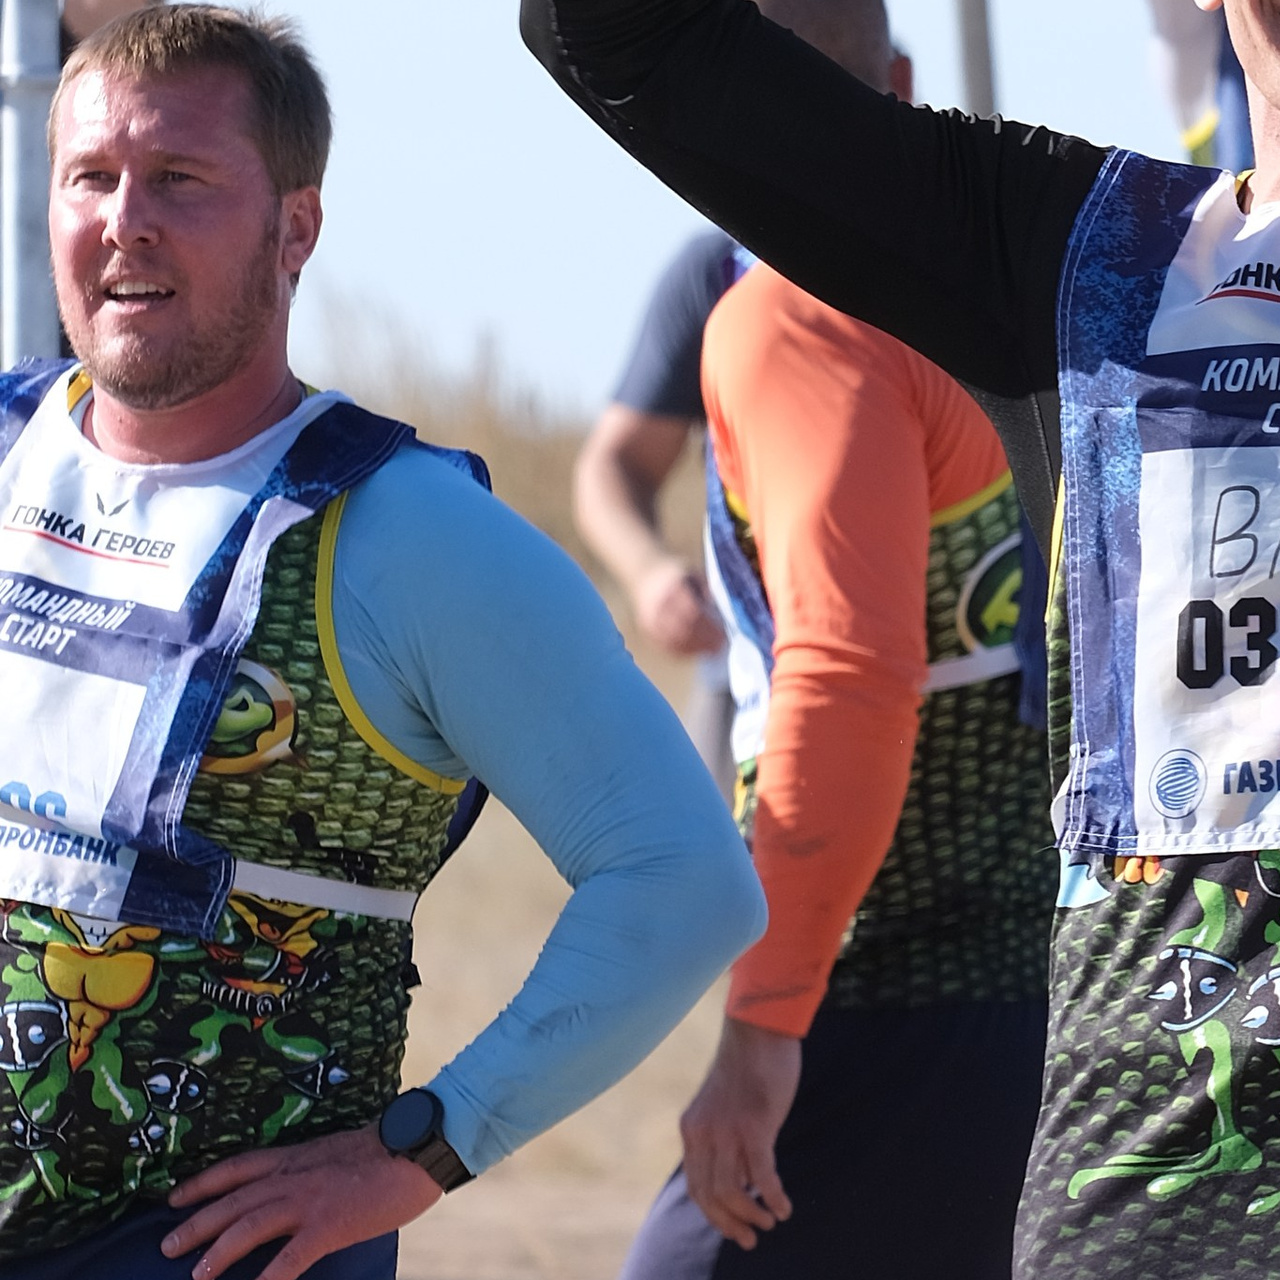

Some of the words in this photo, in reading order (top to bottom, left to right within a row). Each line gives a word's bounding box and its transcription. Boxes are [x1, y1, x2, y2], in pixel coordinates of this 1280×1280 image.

[11, 504, 87, 545] ГОНКА
[91, 528, 176, 560] ГЕРОЕВ
[0, 578, 137, 632] ОМАНДНЫЙ
[0, 612, 77, 656] СТАРТ
